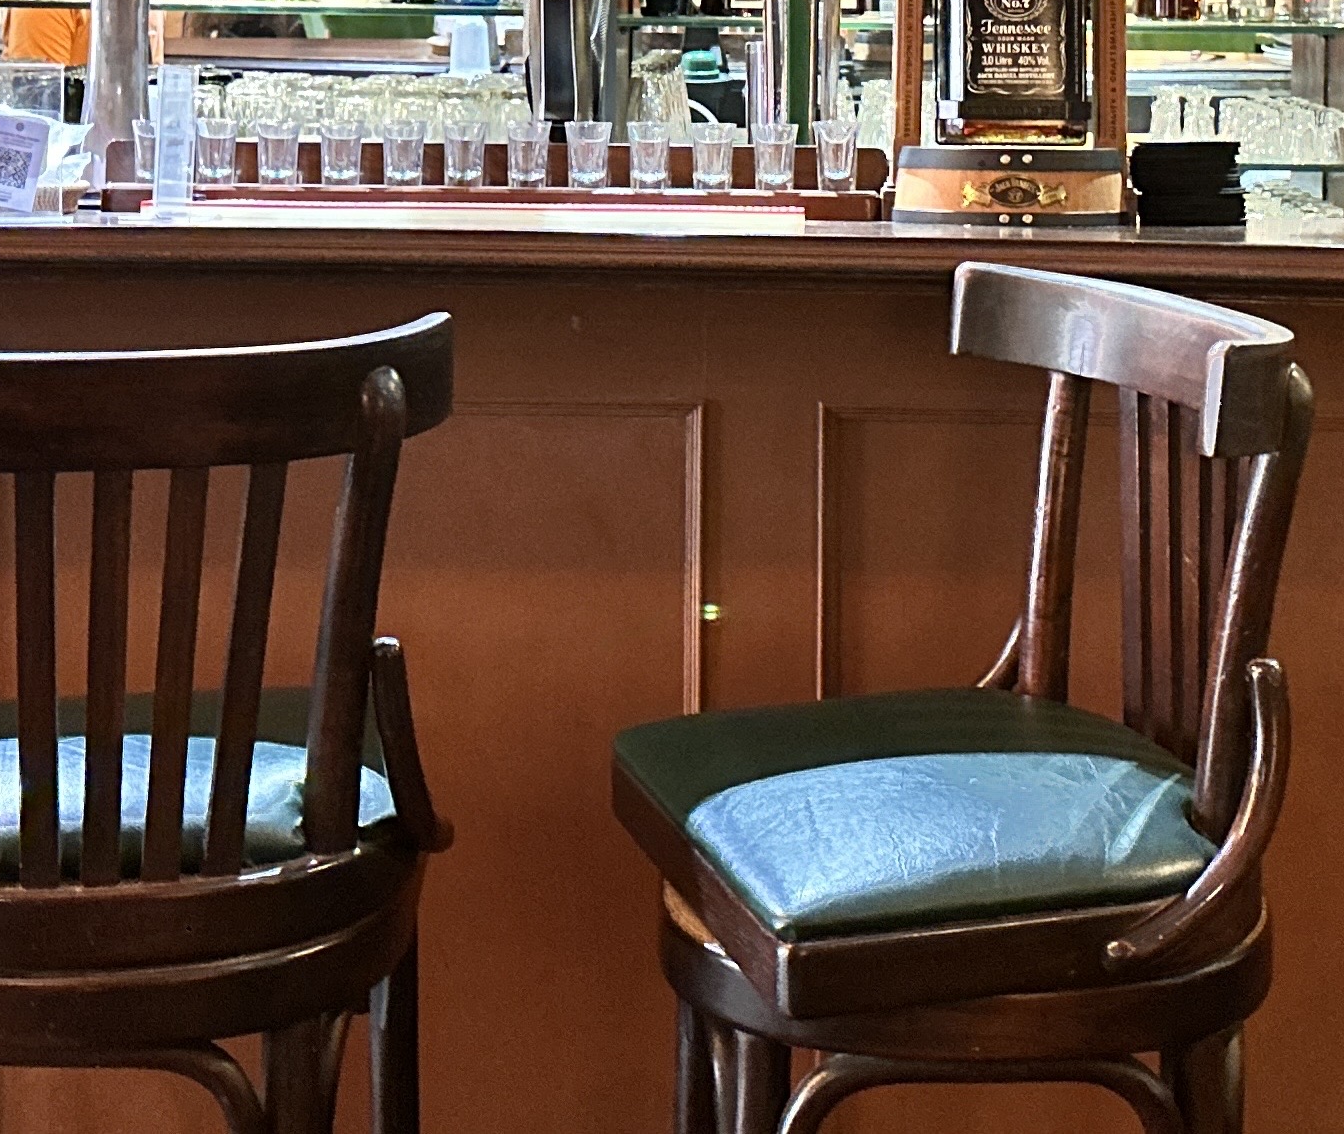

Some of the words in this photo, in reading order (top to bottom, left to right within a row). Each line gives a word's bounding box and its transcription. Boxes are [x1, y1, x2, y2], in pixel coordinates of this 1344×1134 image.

[980, 19, 1052, 35] Tennessee
[982, 42, 1051, 54] WHISKEY
[1017, 55, 1036, 66] 40%
